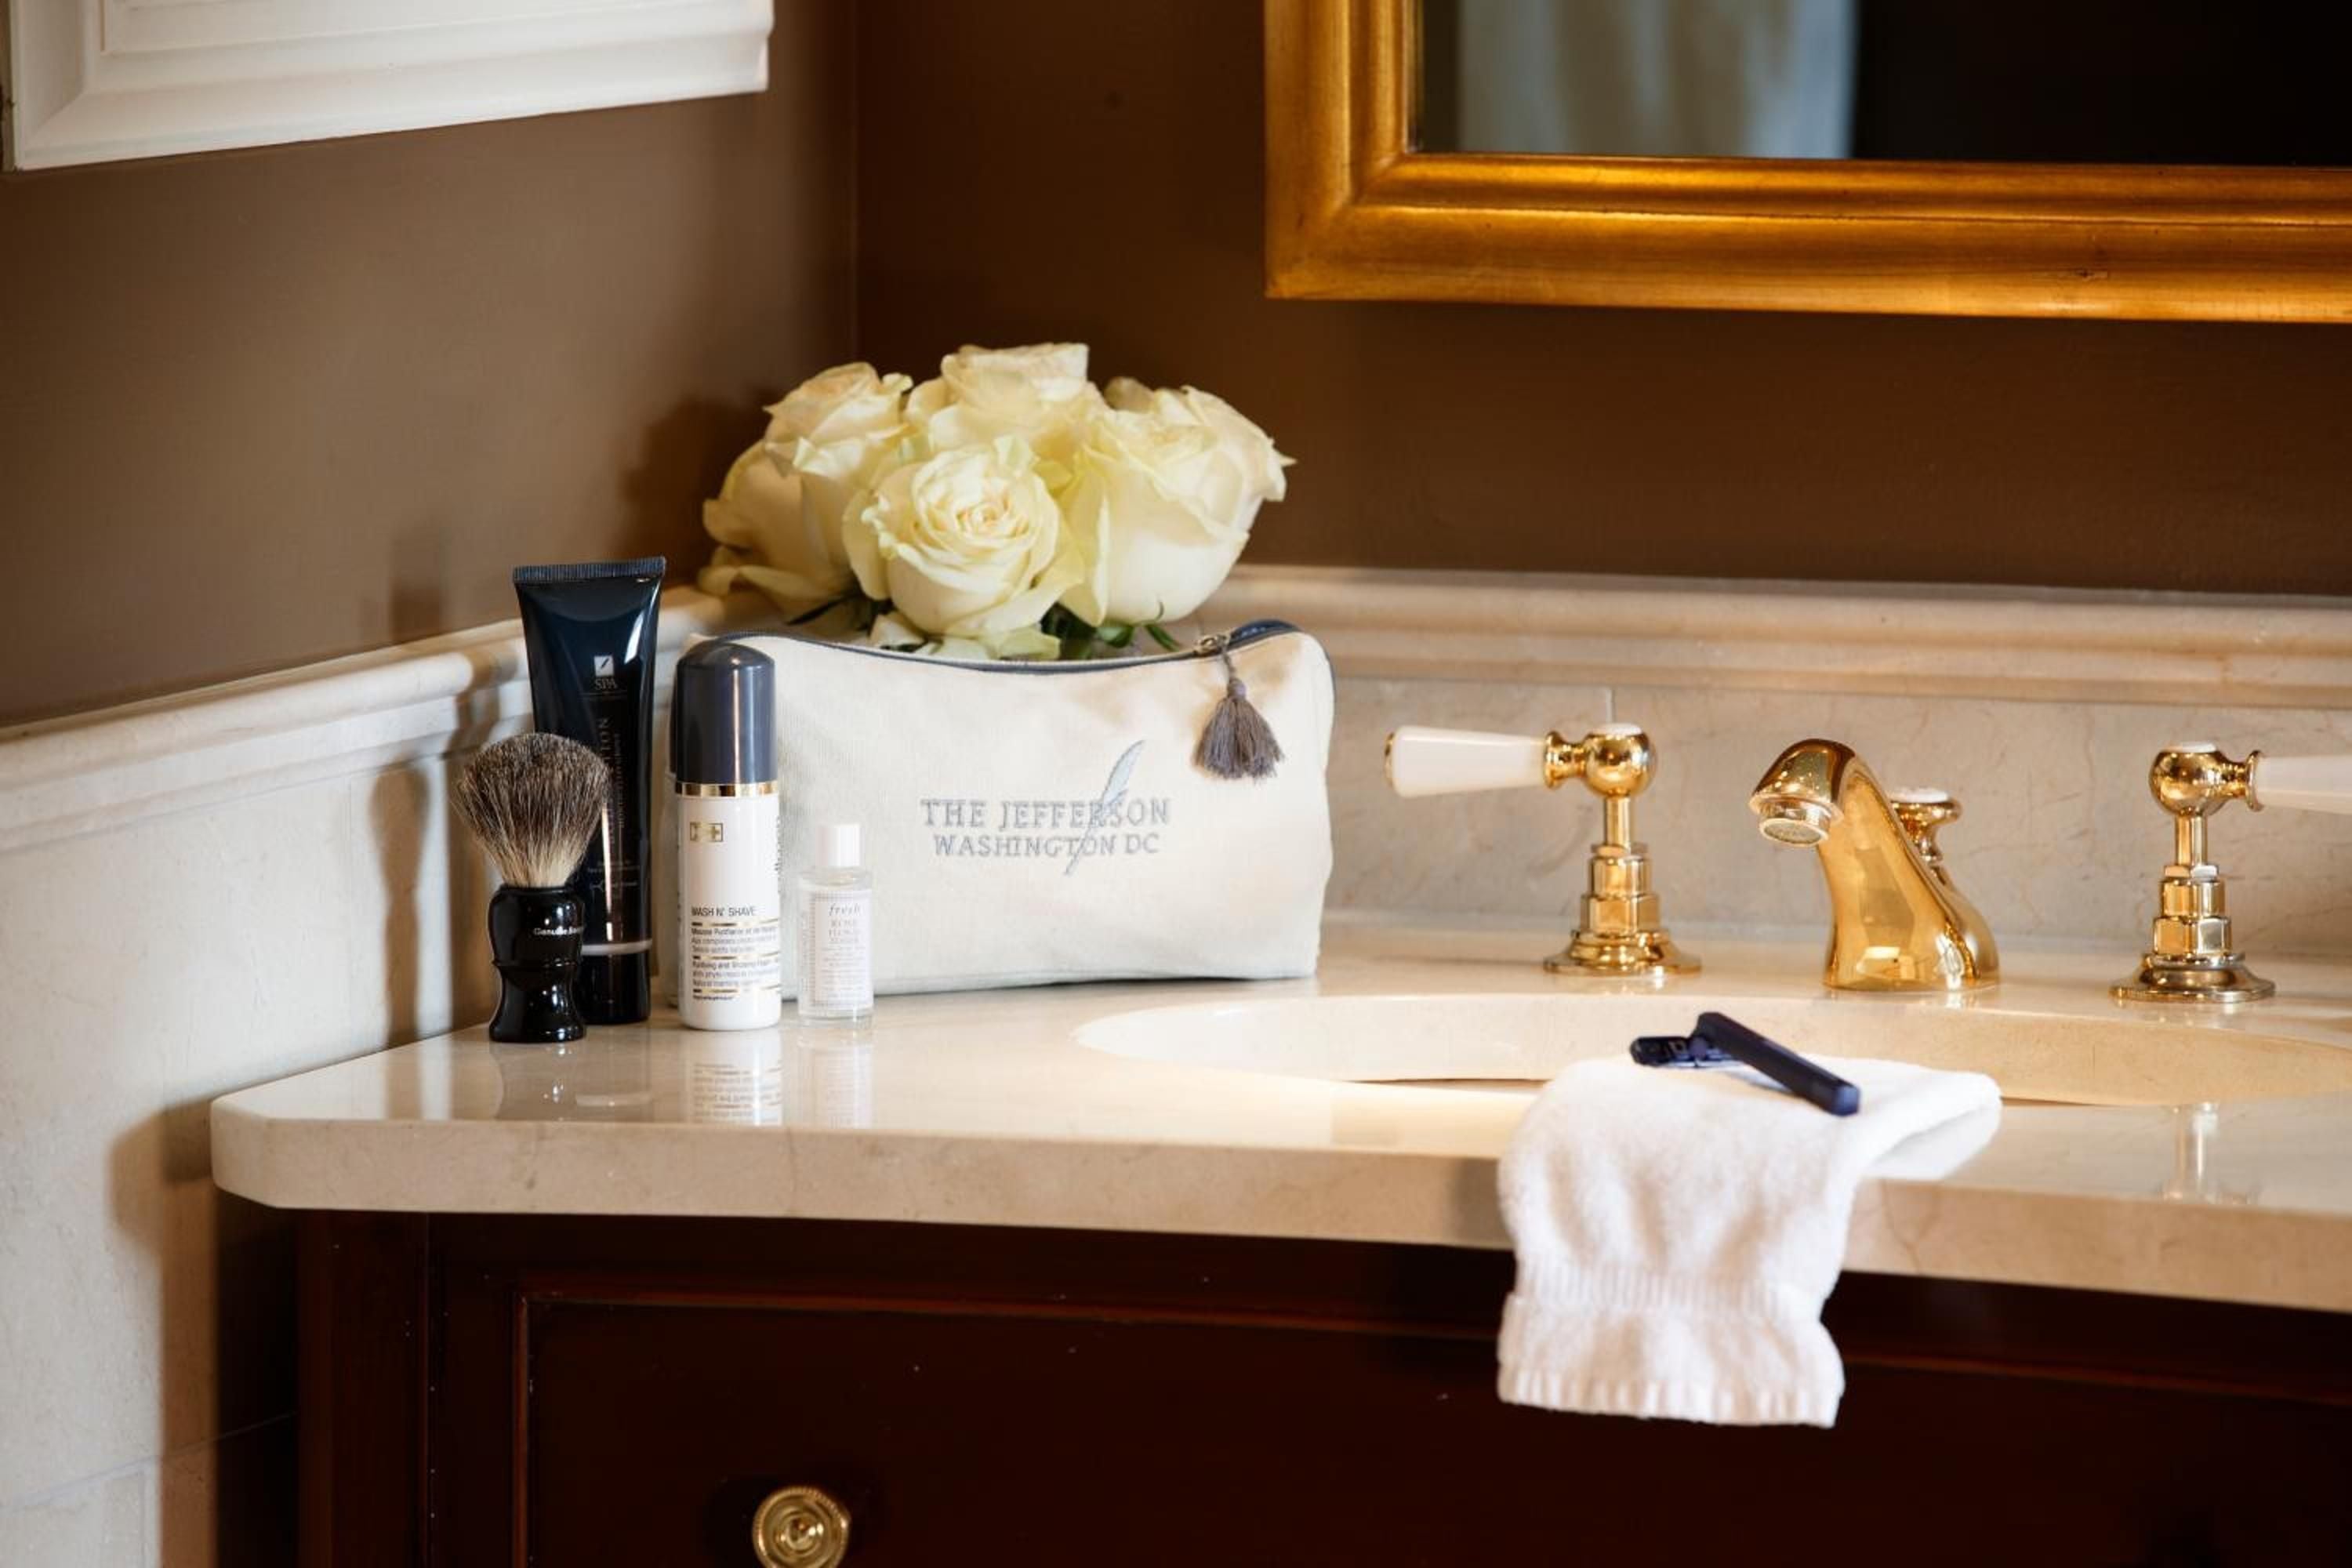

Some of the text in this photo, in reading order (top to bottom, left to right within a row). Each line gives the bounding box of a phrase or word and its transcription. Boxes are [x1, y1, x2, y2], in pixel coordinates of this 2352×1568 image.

[593, 677, 617, 691] SPA
[920, 798, 1171, 832] THE JEFFERSON
[933, 833, 1161, 858] WASHINGTON DC
[691, 907, 714, 916] WASH
[728, 907, 755, 916] SHAVE
[829, 903, 861, 916] fresh
